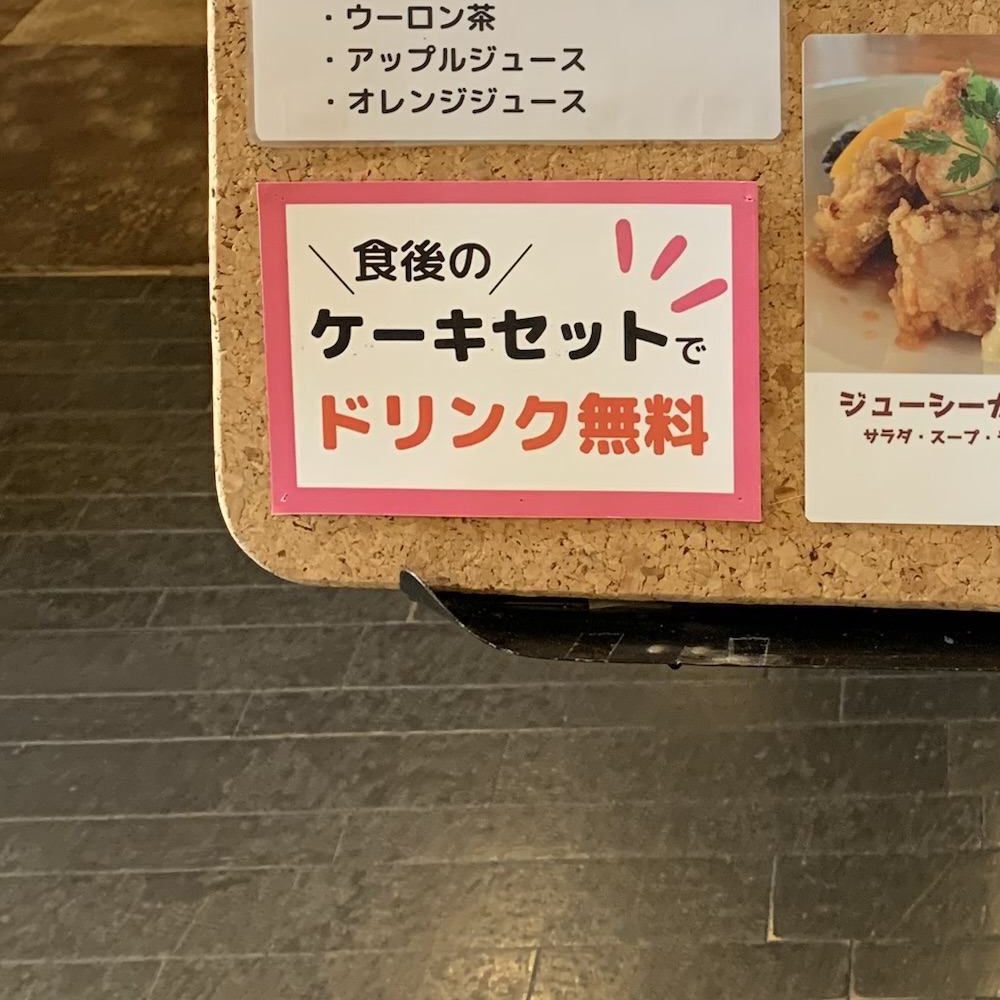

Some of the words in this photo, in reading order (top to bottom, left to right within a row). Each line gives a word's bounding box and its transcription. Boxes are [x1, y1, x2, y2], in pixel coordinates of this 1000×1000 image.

[353, 238, 491, 282] 食後の
[311, 309, 707, 364] ケーキセットで
[322, 392, 708, 456] ドリンク無料
